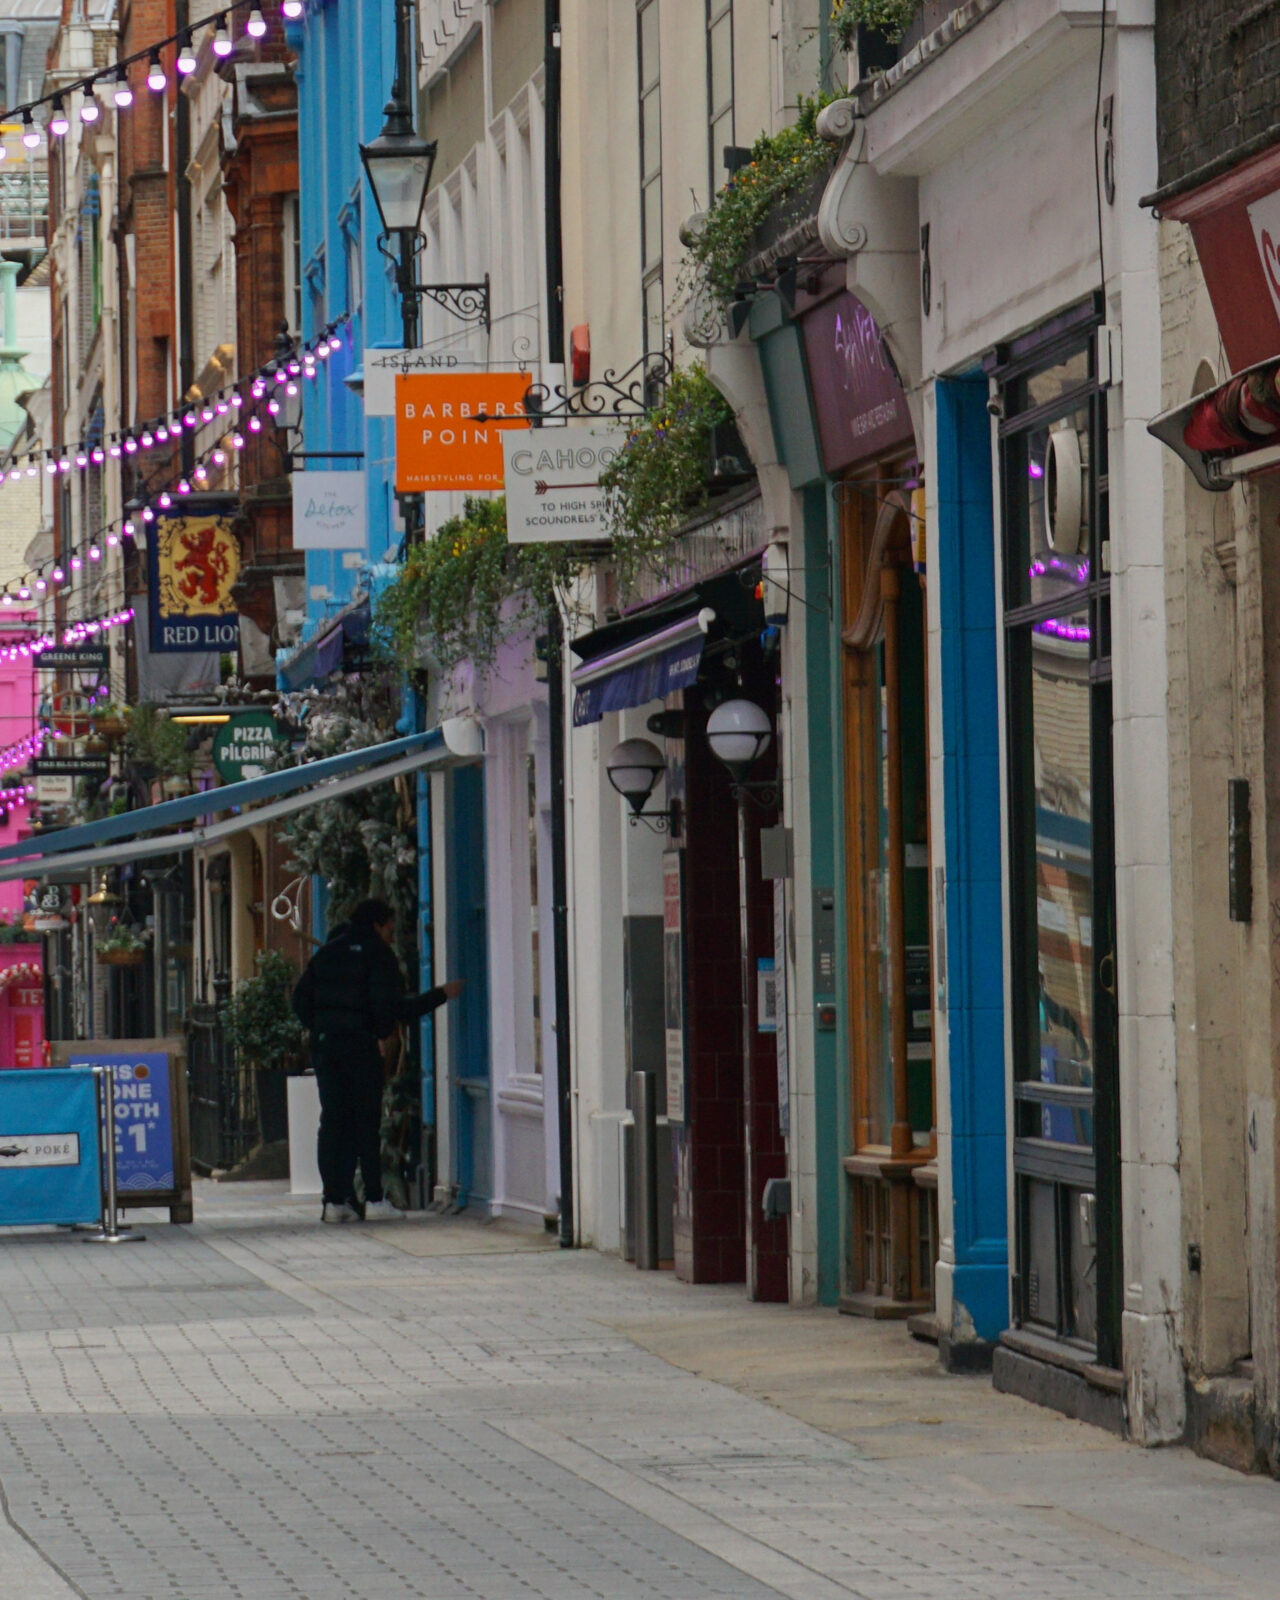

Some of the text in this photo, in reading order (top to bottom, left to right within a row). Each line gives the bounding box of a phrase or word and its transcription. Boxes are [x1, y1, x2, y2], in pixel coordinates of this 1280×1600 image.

[382, 355, 458, 368] ISLAND
[405, 402, 524, 419] BARBERS
[511, 447, 619, 475] CAHOO
[406, 473, 498, 482] HAIRSTYLING FOR
[541, 503, 556, 512] TO
[560, 501, 586, 511] HIGH
[526, 514, 595, 526] SCOUNDRELS
[163, 626, 199, 644] RED
[40, 652, 104, 661] GREENE KING
[234, 727, 273, 742] PIZZA
[34, 1142, 70, 1155] POKÉ
